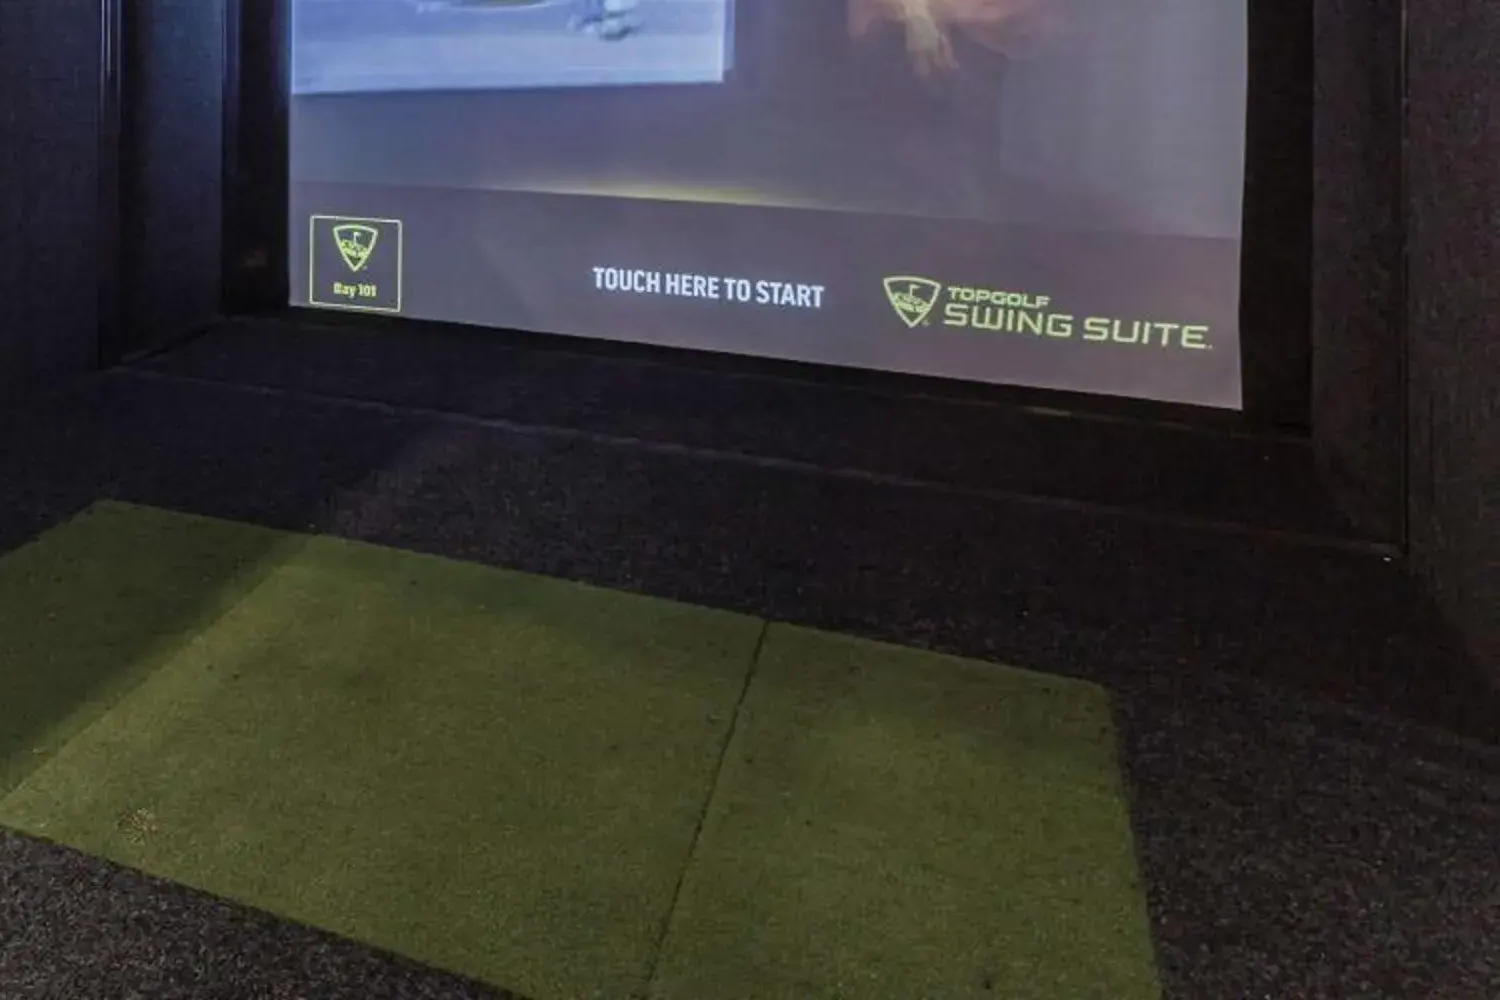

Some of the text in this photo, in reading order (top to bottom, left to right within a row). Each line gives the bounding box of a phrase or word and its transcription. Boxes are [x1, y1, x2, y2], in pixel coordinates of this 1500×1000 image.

[333, 282, 377, 299] Bay 101
[593, 267, 825, 308] TOUCH HERE TO START
[947, 285, 1051, 308] TOPGOLF
[943, 304, 1209, 350] SWING SUITE
